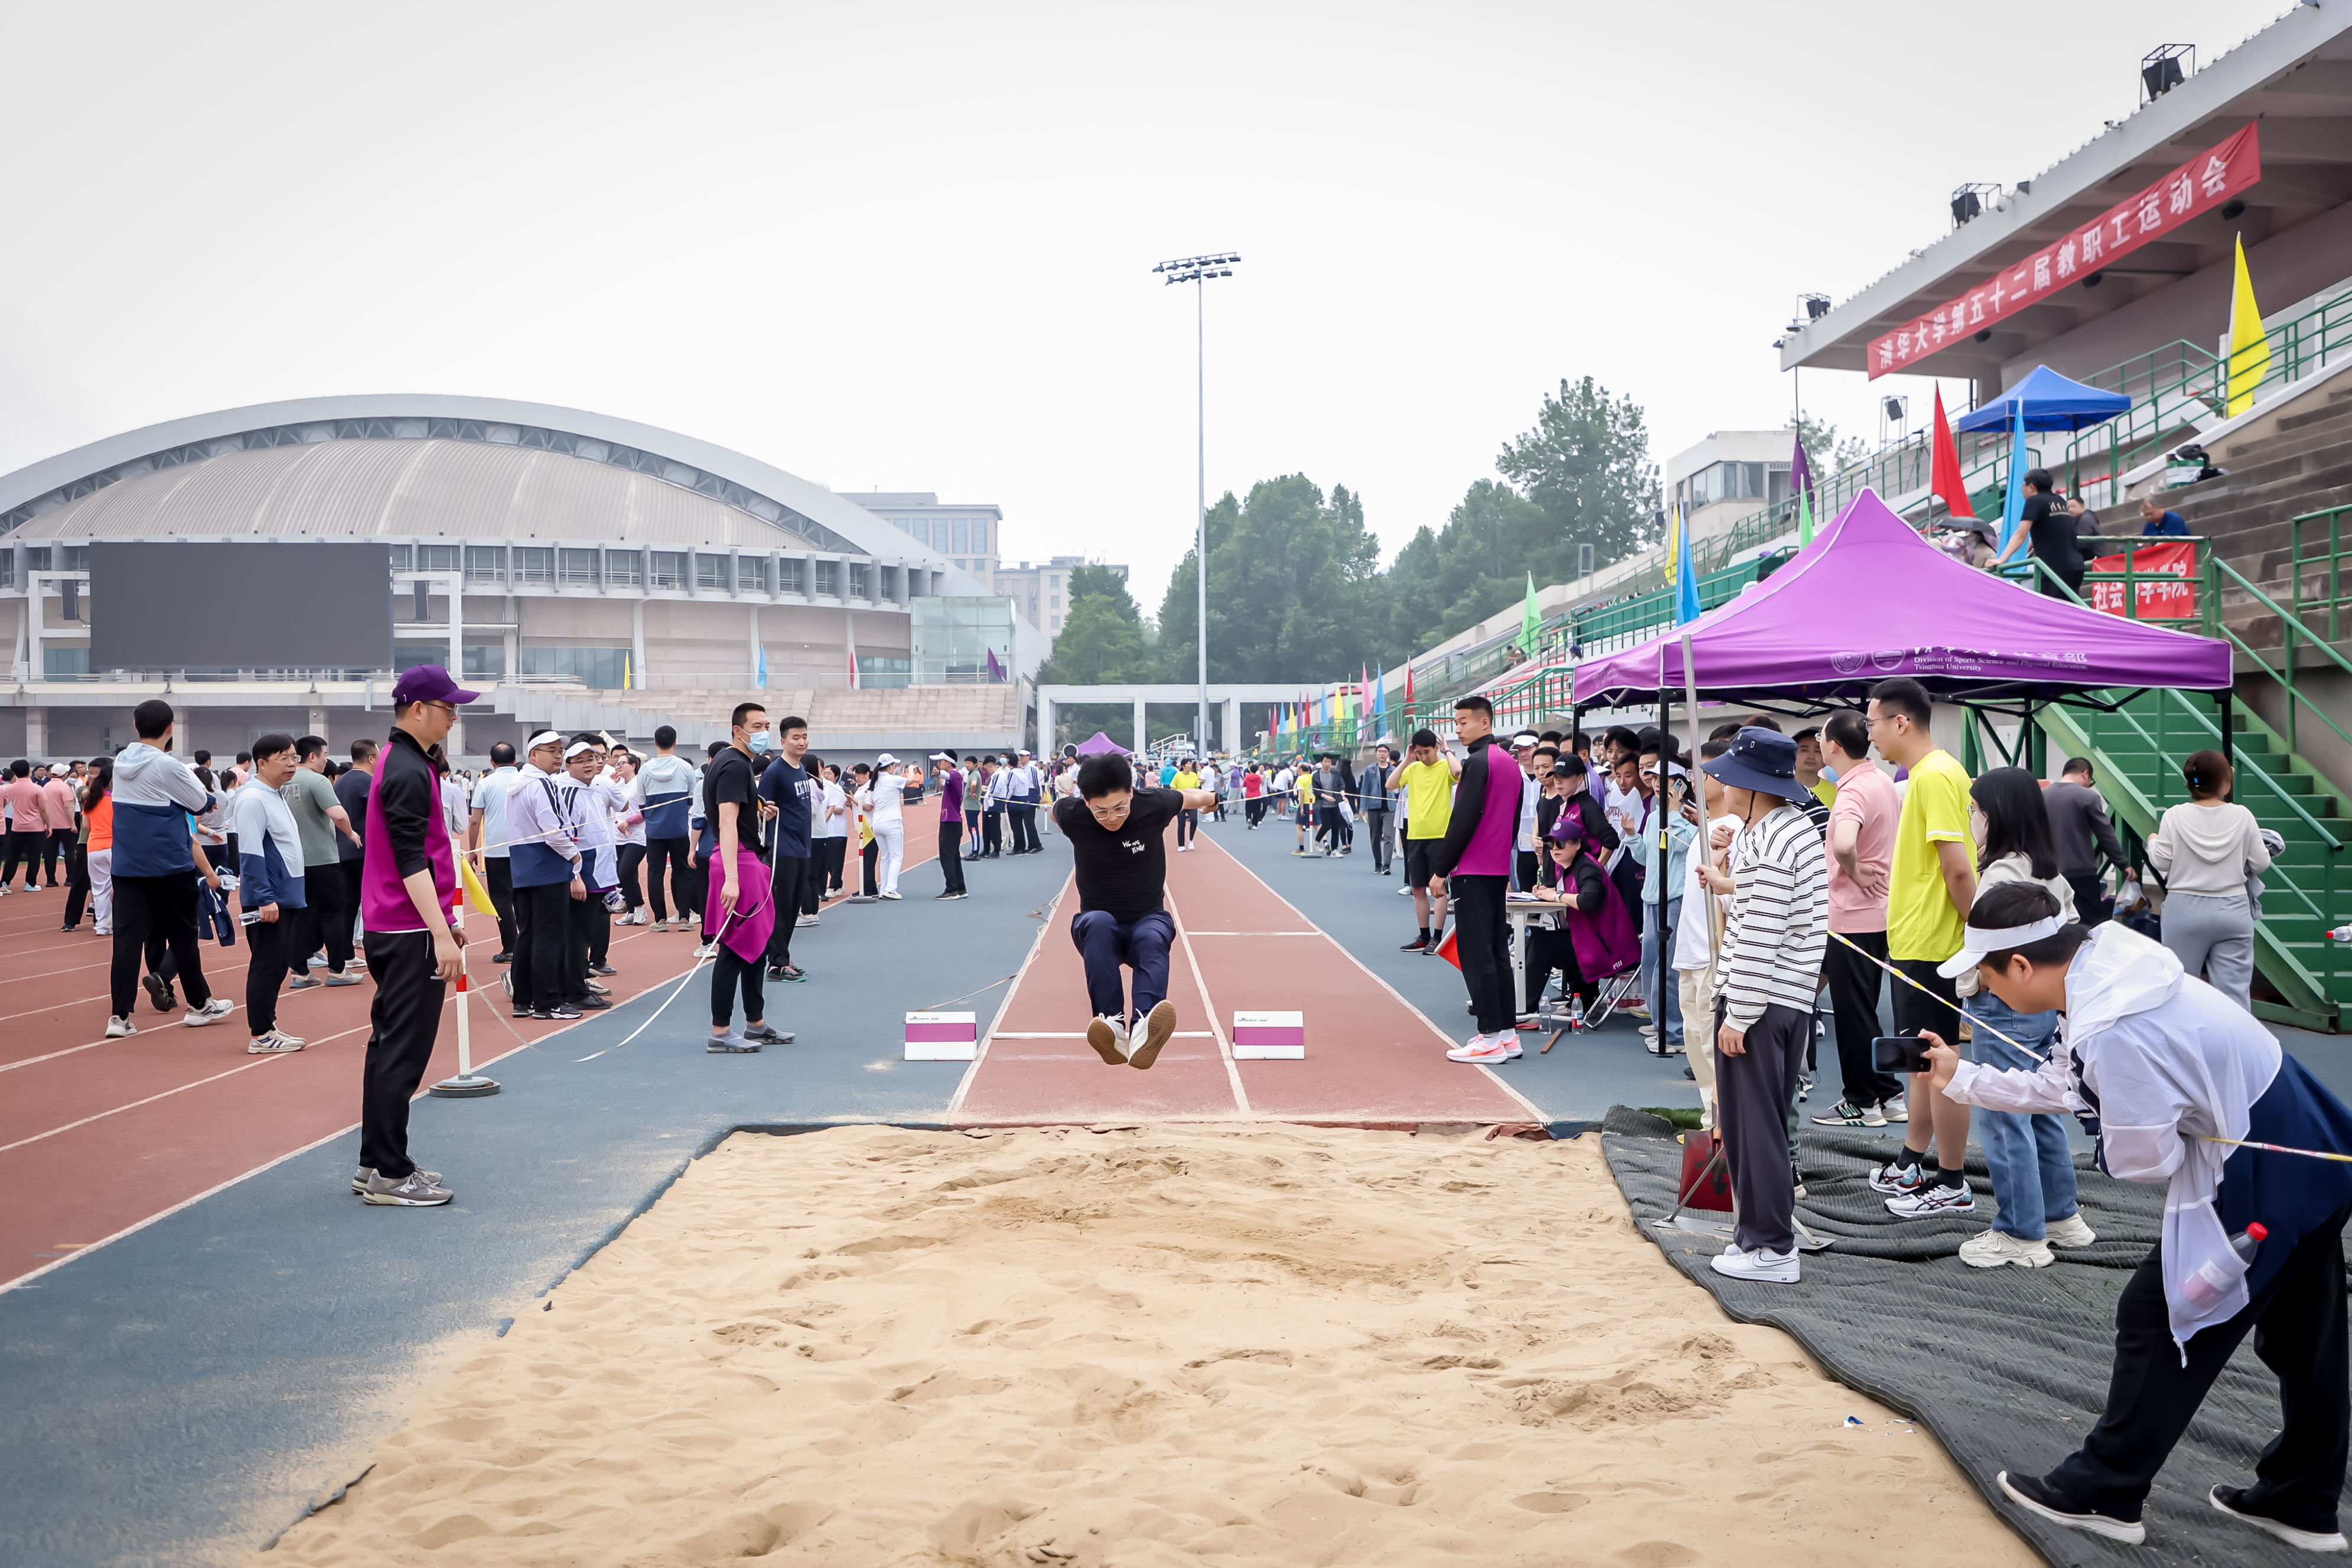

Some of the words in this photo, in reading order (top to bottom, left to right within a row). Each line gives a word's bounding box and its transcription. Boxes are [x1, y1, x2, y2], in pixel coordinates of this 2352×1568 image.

[1879, 155, 2227, 369] 清华大学第五十二届教职工运动会
[2093, 560, 2188, 611] 社会学学院
[1946, 663, 1982, 672] University
